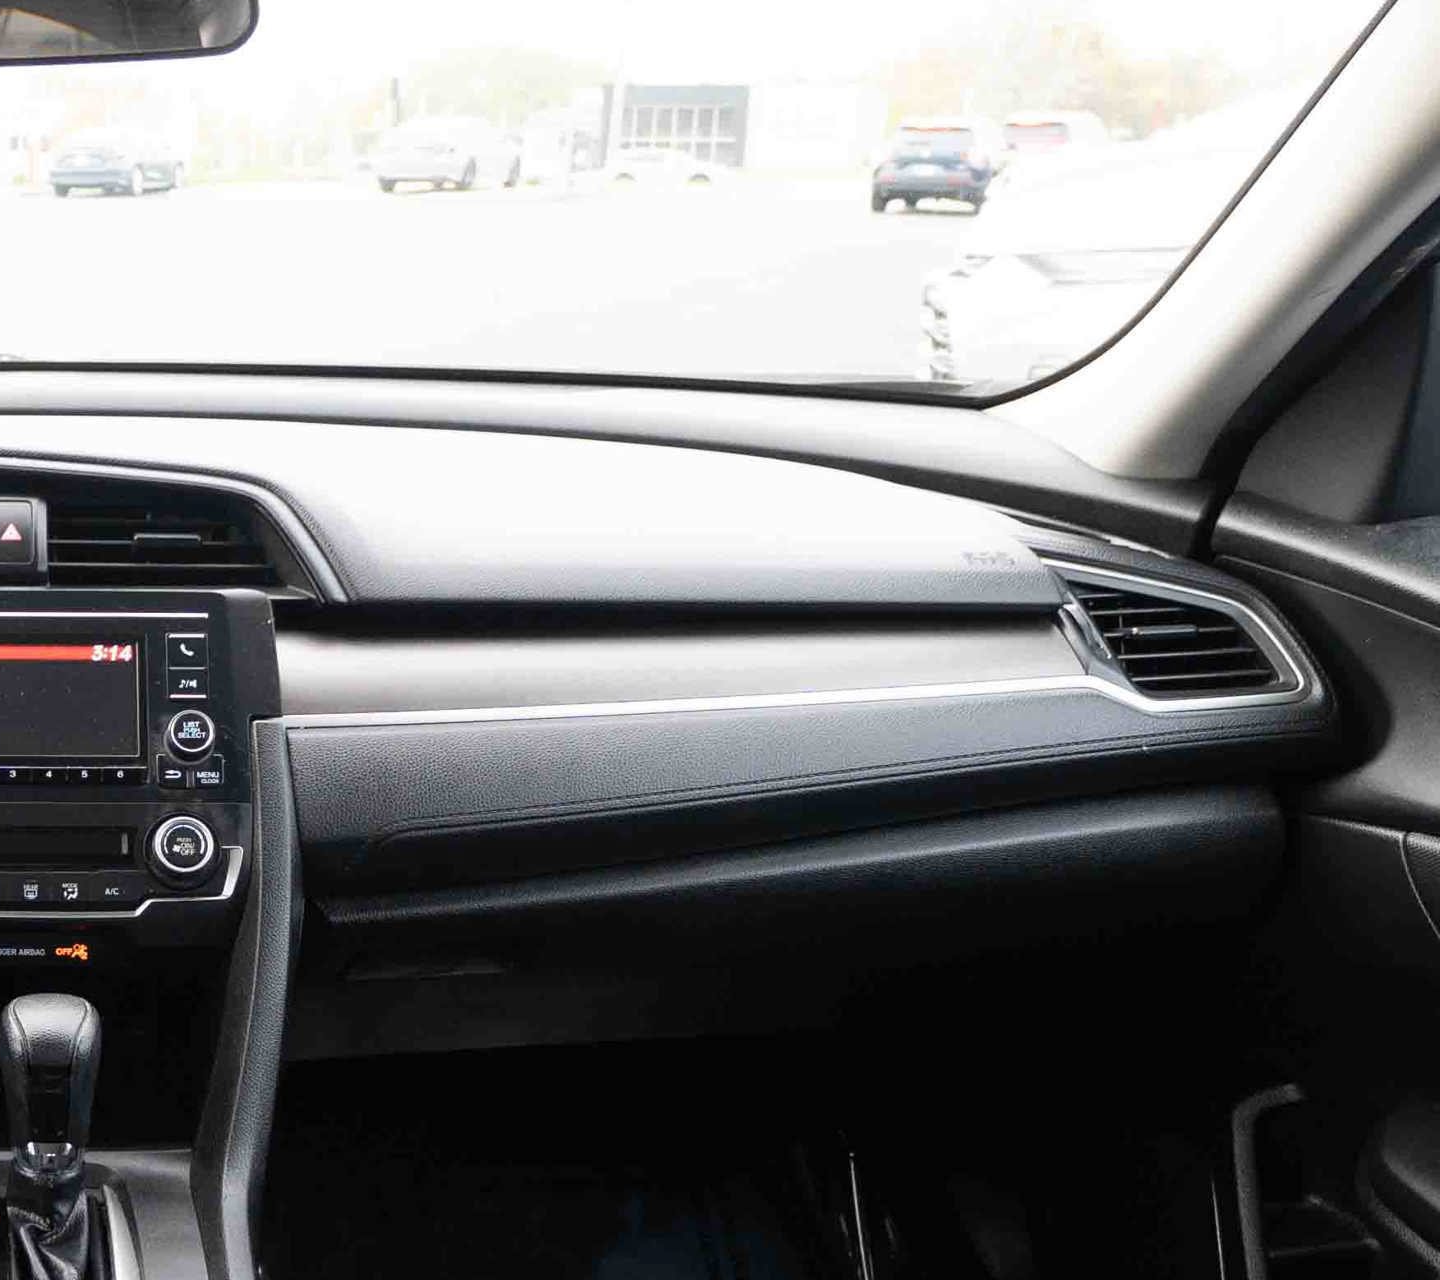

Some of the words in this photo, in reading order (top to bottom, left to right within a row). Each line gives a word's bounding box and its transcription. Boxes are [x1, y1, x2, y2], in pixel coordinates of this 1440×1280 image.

[182, 721, 201, 729] LIST
[177, 731, 207, 739] SELECT
[9, 770, 17, 778] 3
[45, 770, 53, 778] 4
[81, 771, 88, 779] 5
[116, 771, 124, 779] 6
[196, 771, 220, 779] MENU
[104, 887, 120, 896] A/C
[55, 946, 73, 956] OFF
